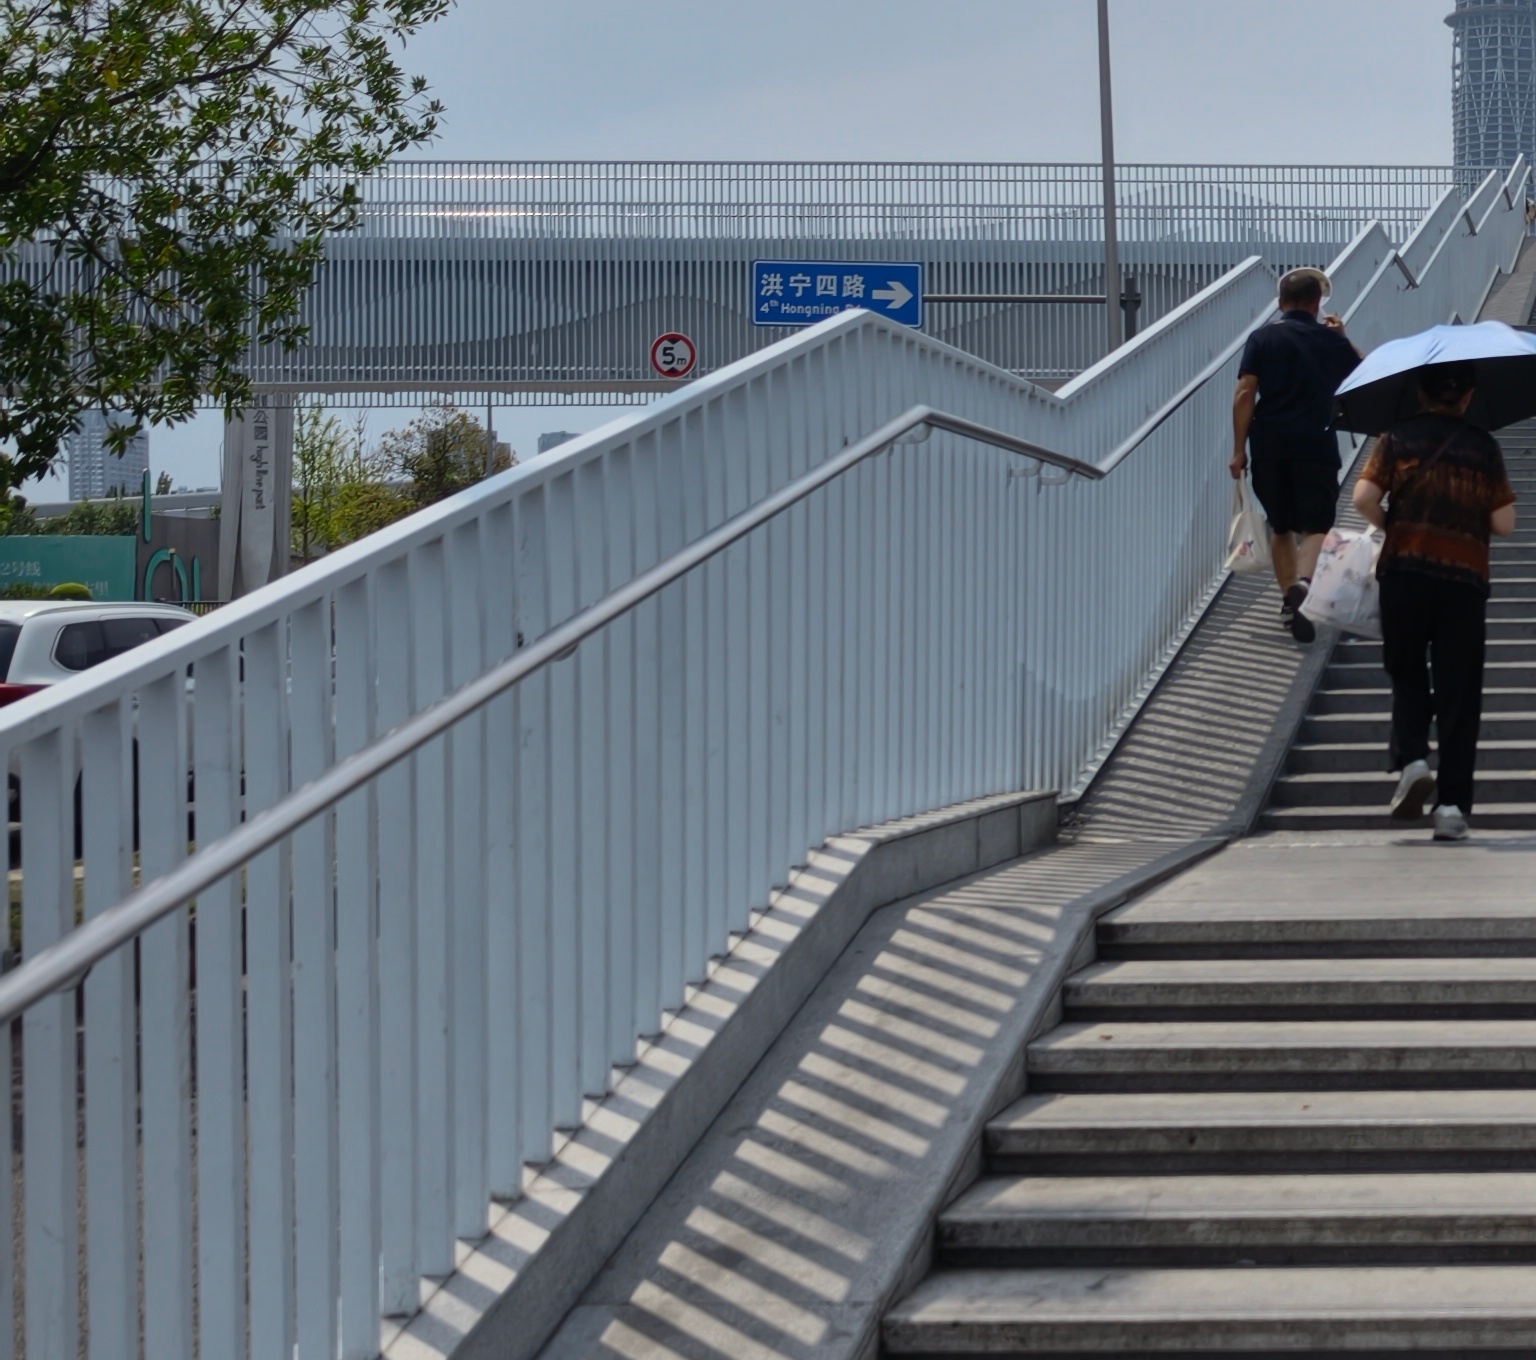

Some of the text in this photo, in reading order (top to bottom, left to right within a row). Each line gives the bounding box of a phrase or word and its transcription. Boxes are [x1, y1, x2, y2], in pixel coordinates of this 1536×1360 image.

[760, 273, 866, 298] 洪宁四路
[760, 299, 779, 313] 4th
[780, 303, 840, 317] Hongning
